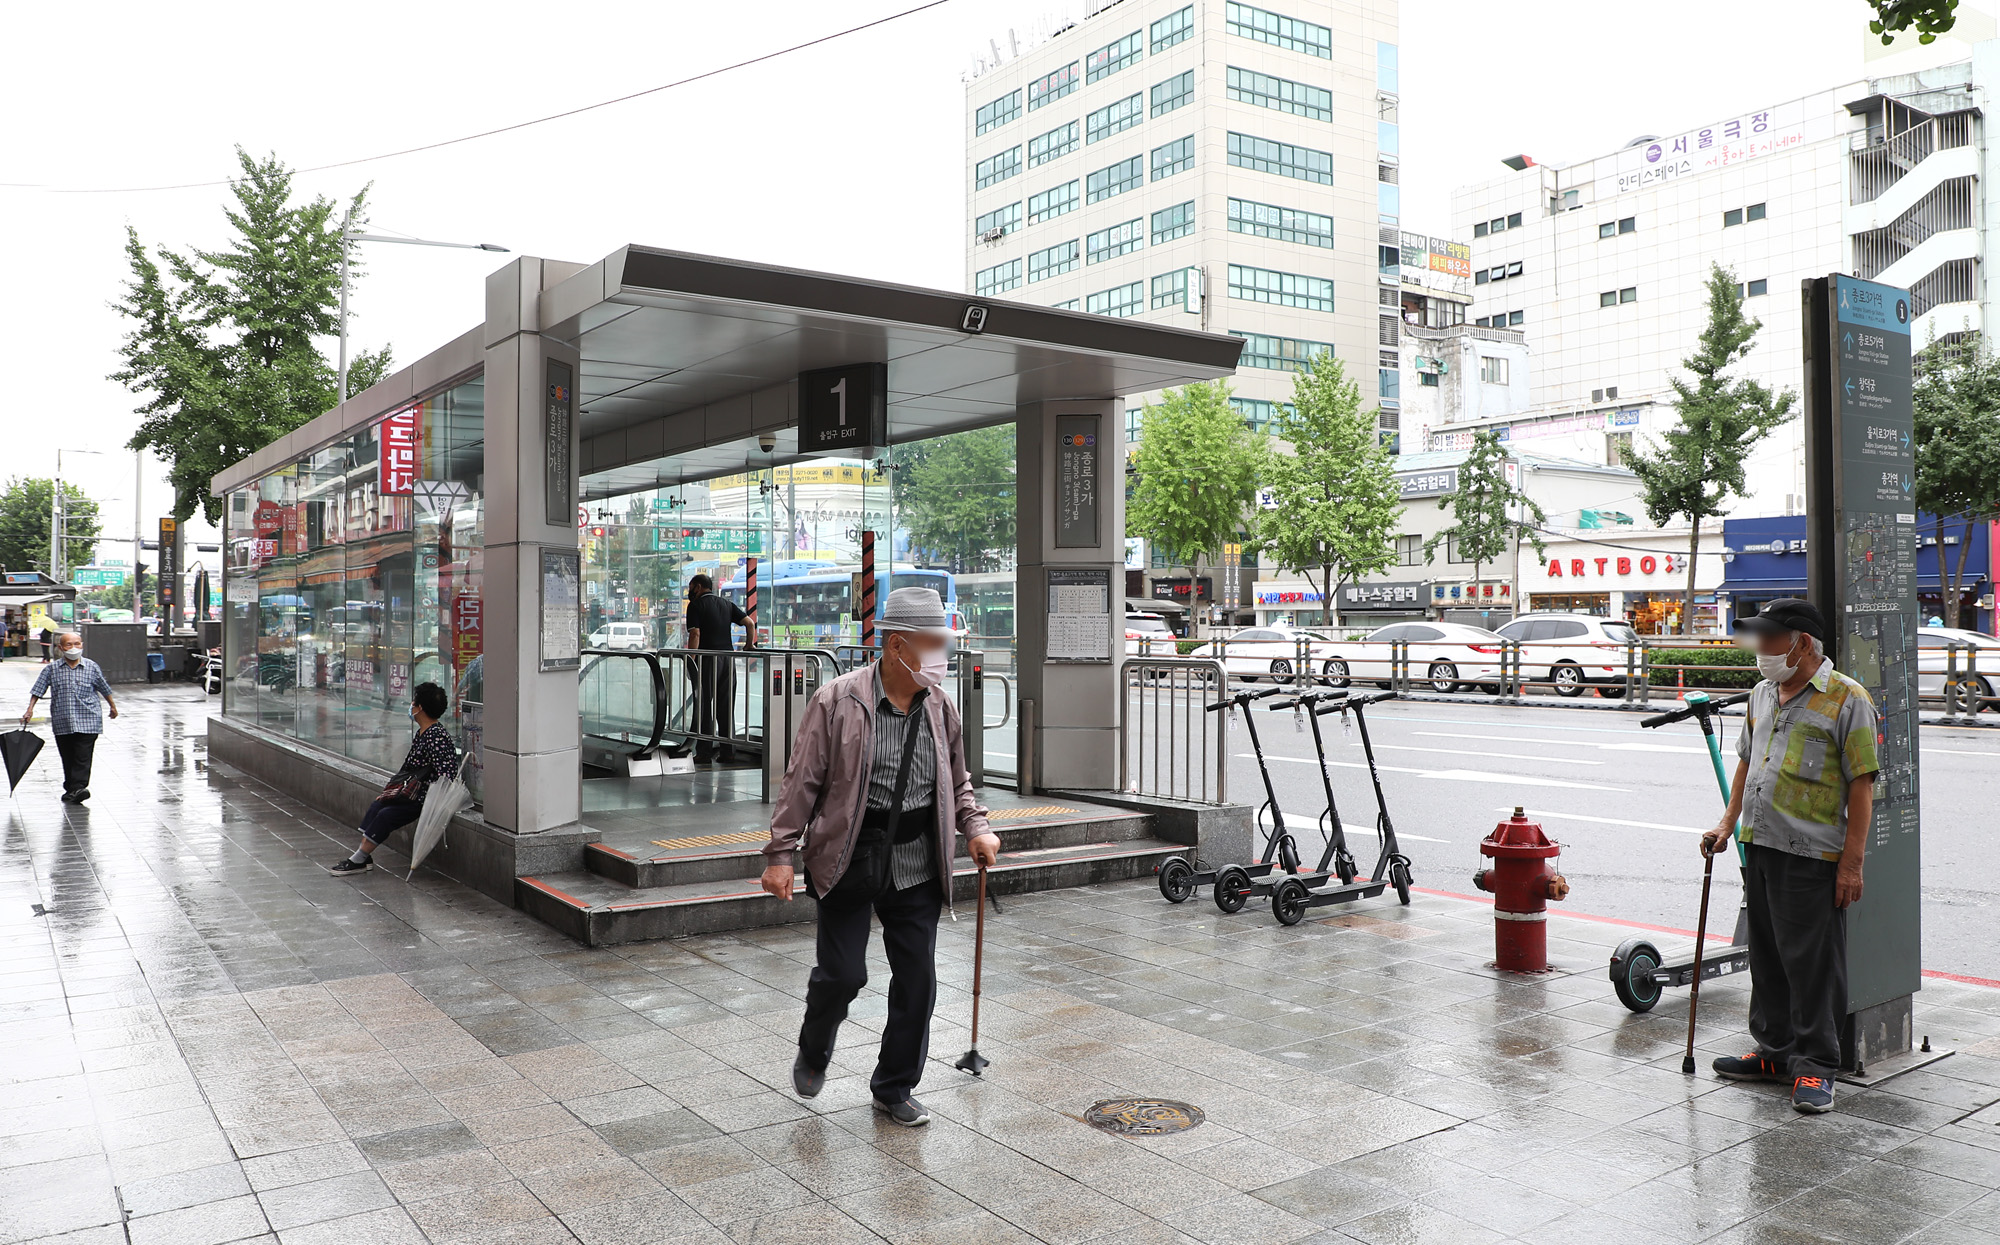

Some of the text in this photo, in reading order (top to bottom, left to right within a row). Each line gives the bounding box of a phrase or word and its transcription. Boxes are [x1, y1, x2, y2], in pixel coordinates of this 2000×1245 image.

[1672, 111, 1770, 153] 서울극장
[1705, 133, 1803, 167] 서울아트시네마
[1618, 160, 1691, 192] 인디스페이스
[1431, 239, 1470, 260] 이삭리빙텔
[1432, 256, 1469, 274] 해피하우스
[1851, 288, 1882, 308] 종로3가역
[1858, 333, 1884, 350] 종로5가역
[1859, 377, 1876, 392] 창덕궁
[830, 377, 846, 425] 1
[820, 428, 857, 440] 출입구 EXIT
[1867, 425, 1898, 442] 을지로3가역
[1081, 451, 1094, 505] 종로3가
[1881, 472, 1899, 486] 종각역
[164, 547, 173, 572] 종로3가
[426, 557, 436, 565] 50
[1548, 554, 1687, 577] ARTBOX
[1264, 592, 1304, 603] 신안보청기
[822, 625, 831, 635] 140
